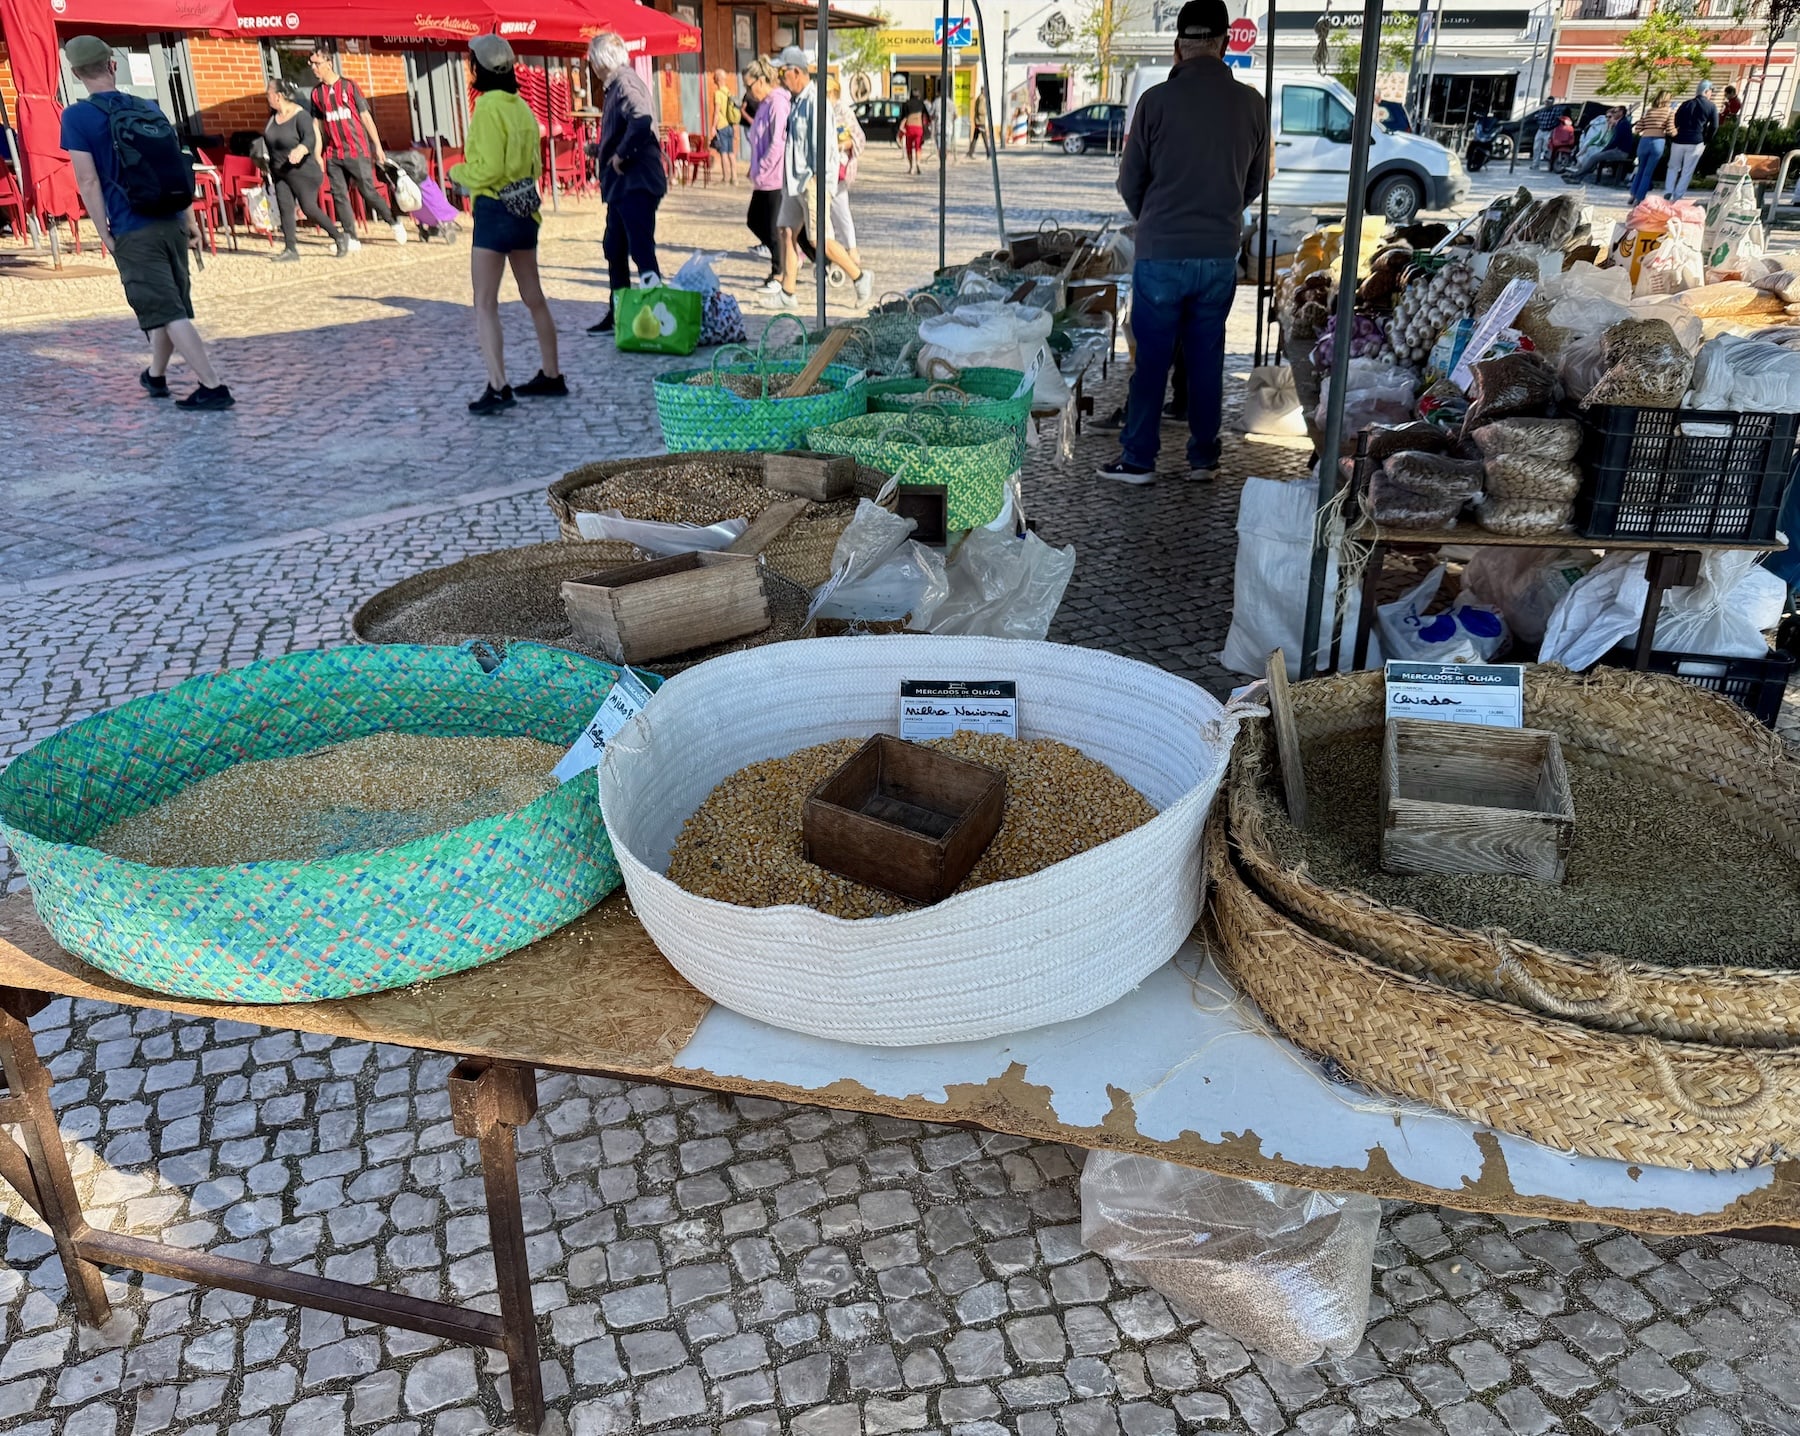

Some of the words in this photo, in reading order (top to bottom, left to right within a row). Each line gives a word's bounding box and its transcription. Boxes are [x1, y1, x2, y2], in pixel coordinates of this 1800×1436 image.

[237, 16, 255, 28] PER
[256, 15, 283, 27] BOCK
[1227, 28, 1257, 43] STOP
[1402, 673, 1452, 681] MERCADOS
[1467, 674, 1502, 682] OLHÃO
[971, 688, 1001, 696] OLHÃO
